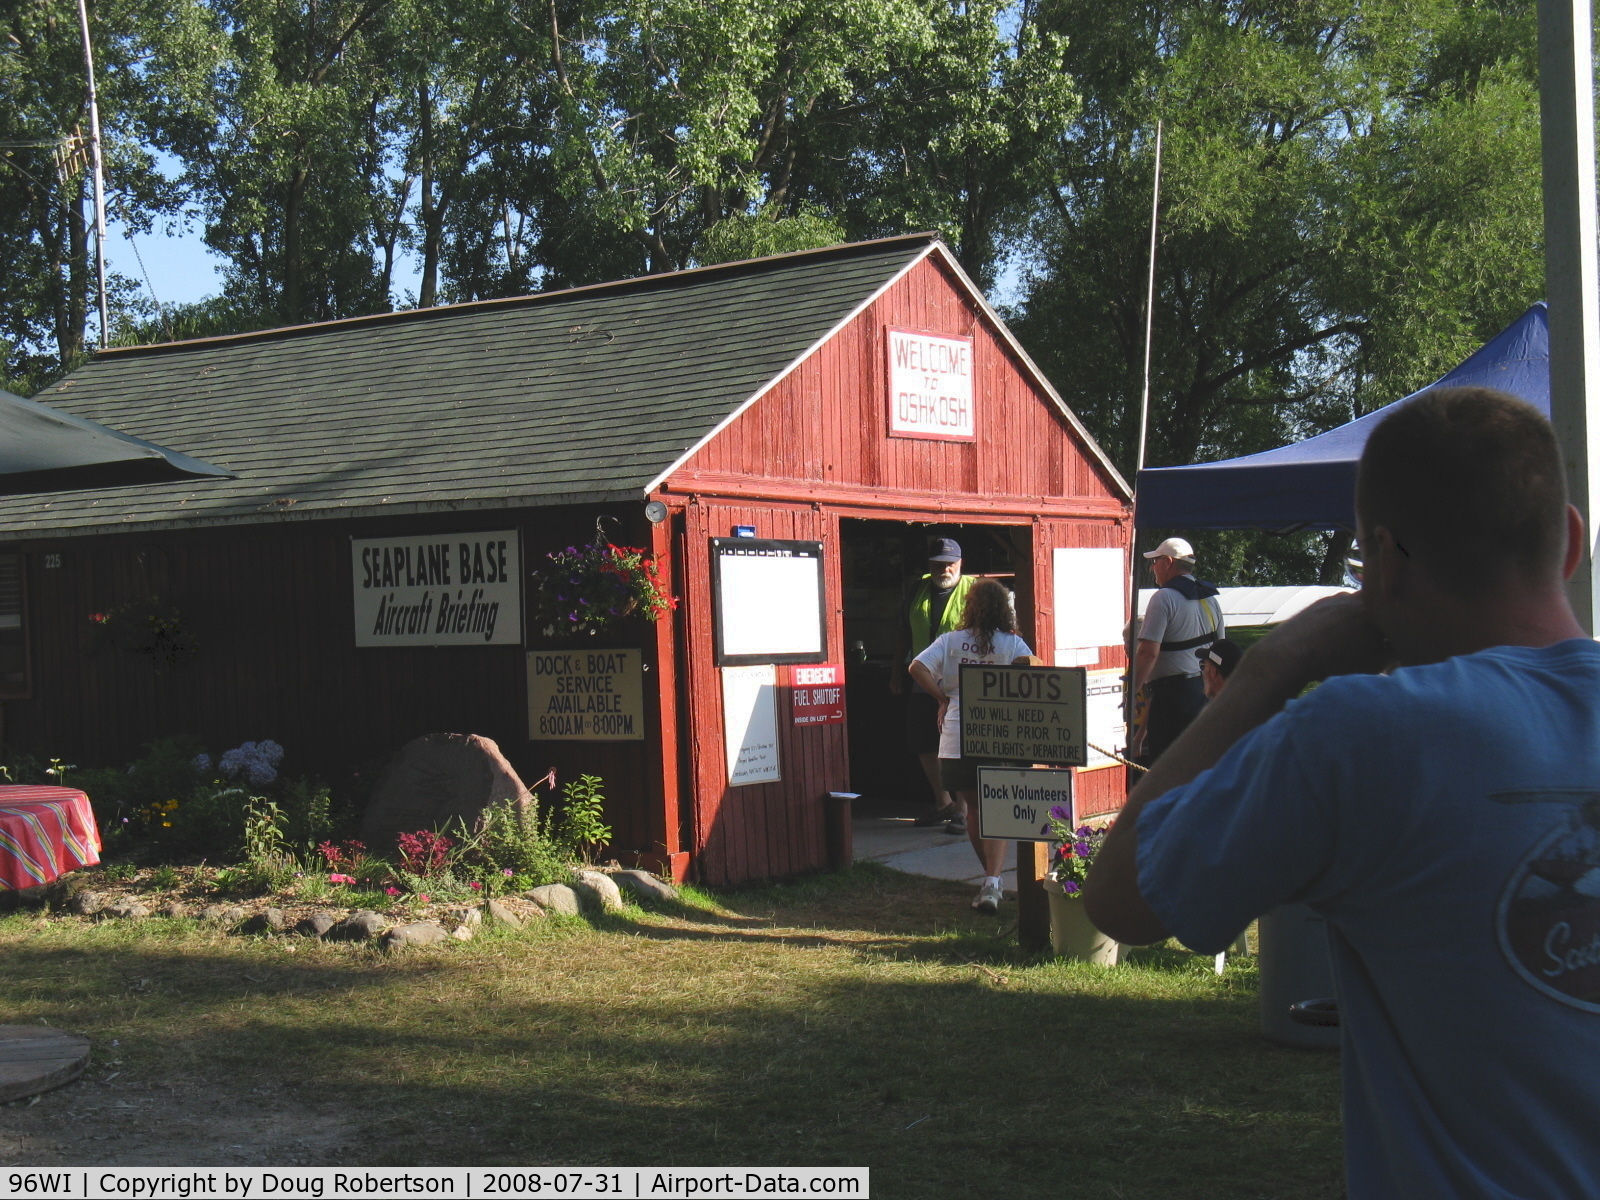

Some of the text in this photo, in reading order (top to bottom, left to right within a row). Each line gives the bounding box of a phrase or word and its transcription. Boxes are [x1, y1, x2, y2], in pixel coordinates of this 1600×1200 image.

[895, 338, 967, 376] WELCOME
[924, 377, 938, 390] TO
[899, 392, 967, 427] OSHKOSH
[45, 554, 61, 569] 225
[362, 541, 508, 588] SEAPLANE BASE
[373, 589, 499, 641] Aircraft Briefing
[536, 655, 570, 675] DOCK
[587, 653, 627, 674] BOAT
[556, 676, 613, 694] SERVICE
[796, 668, 836, 685] EMERGENCY
[982, 671, 1061, 700] PILOTS
[547, 694, 622, 714] AVAILABLE
[794, 688, 840, 706] FUEL SHUTOFF
[969, 706, 1060, 723] YOU WILL NEED A
[966, 723, 1071, 741] BRIEFING PRIOR TO
[966, 740, 990, 755] LOCAL
[993, 742, 1025, 757] FLIGHTS
[1033, 744, 1080, 760] DEPARTURE
[983, 784, 1068, 801] Dock Volunteers
[1013, 805, 1037, 824] Only
